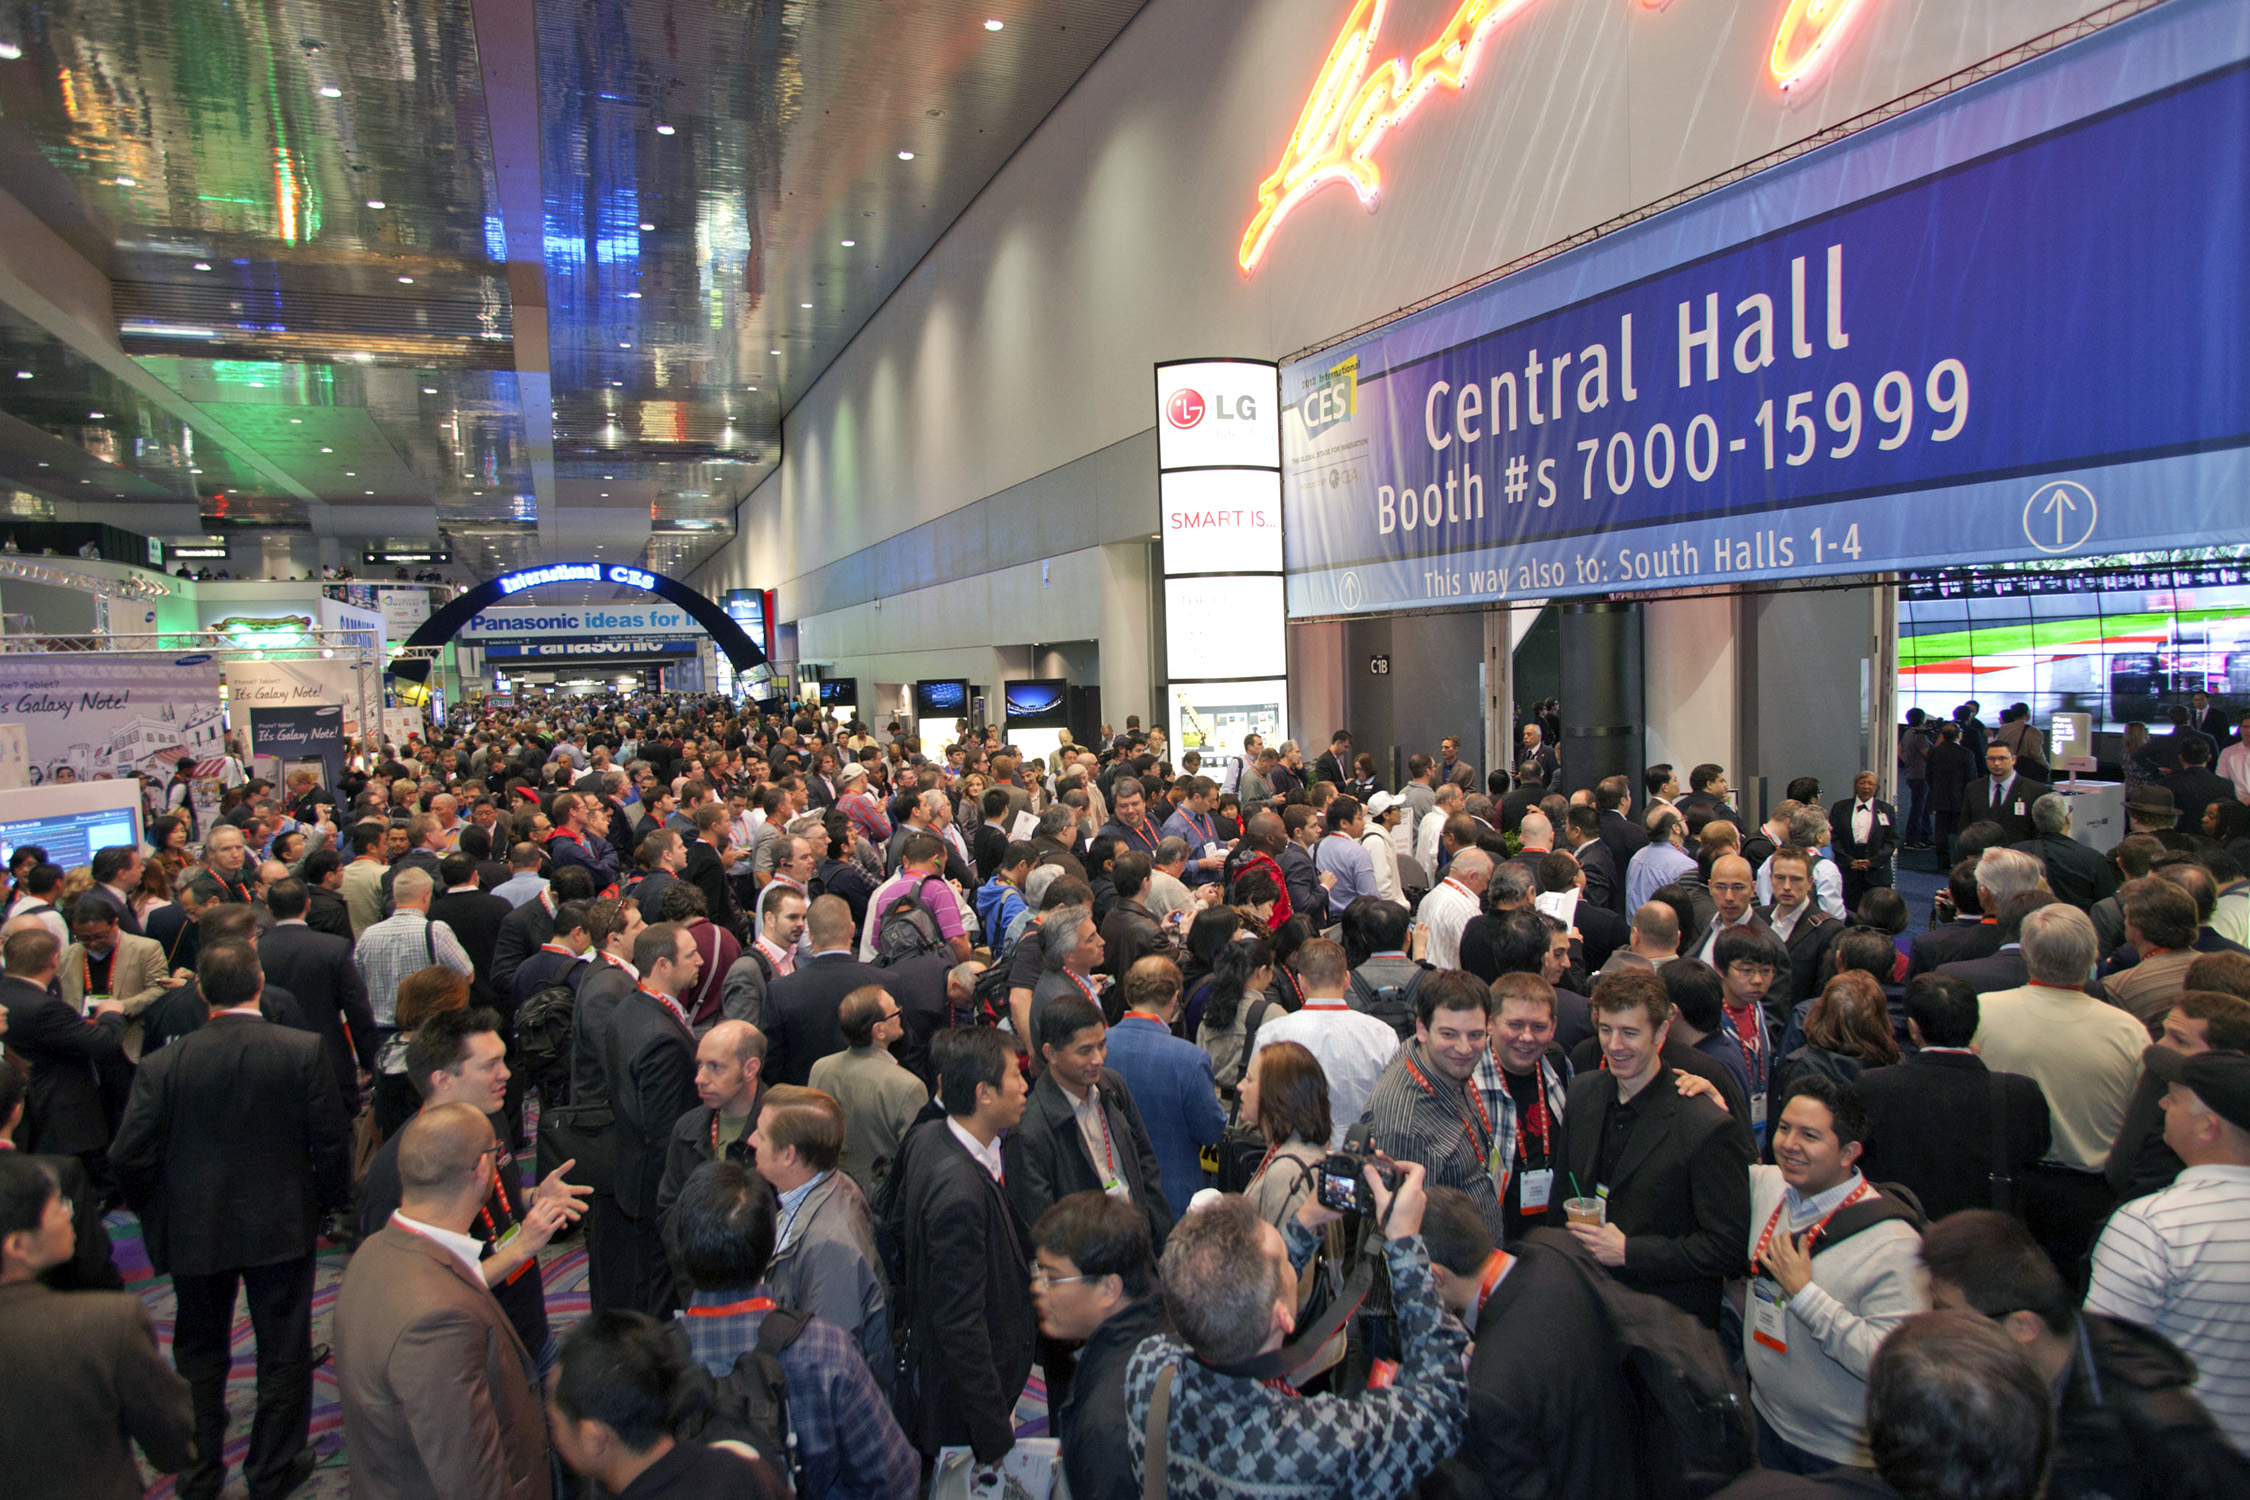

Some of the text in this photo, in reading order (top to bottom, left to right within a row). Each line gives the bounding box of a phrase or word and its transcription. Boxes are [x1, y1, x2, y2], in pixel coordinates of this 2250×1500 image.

[1425, 244, 1849, 450] Central Hall
[1301, 360, 1361, 389] 2012 International
[1216, 395, 1256, 421] LG
[1304, 383, 1347, 427] CES
[1378, 358, 1969, 534] Booth #s 7000-15999
[1171, 511, 1276, 529] SMART IS...
[1425, 523, 1862, 599] This way also to: South Halls 1-4
[499, 563, 601, 594] International
[470, 613, 579, 631] Panasonic
[584, 611, 645, 629] ideas
[649, 611, 680, 627] for
[1371, 659, 1388, 674] C1B
[23, 680, 60, 689] Tablet?
[255, 686, 290, 703] Galaxy
[292, 683, 323, 699] Note!
[16, 693, 74, 719] Galaxy
[80, 689, 130, 712] Note!
[277, 728, 309, 745] Galaxy
[310, 726, 340, 740] Note!
